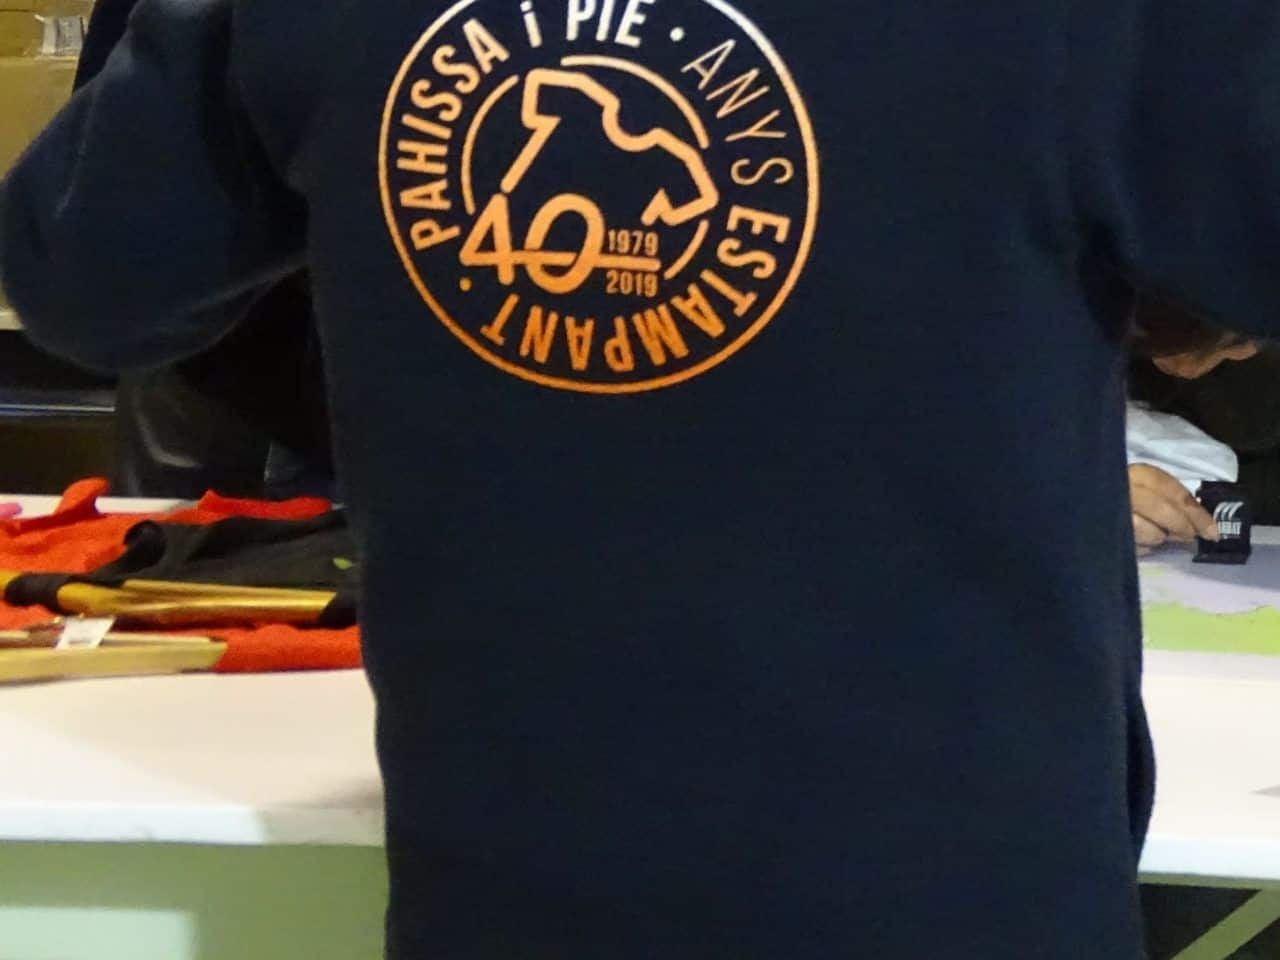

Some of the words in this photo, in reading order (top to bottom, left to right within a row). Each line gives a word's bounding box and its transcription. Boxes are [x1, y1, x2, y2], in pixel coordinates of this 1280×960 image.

[396, 17, 511, 251] PAHISSA
[681, 38, 795, 187] ANYS
[459, 192, 605, 296] 40
[480, 206, 792, 374] ESTAMPANT
[605, 271, 660, 297] 2019
[608, 230, 660, 256] 1979
